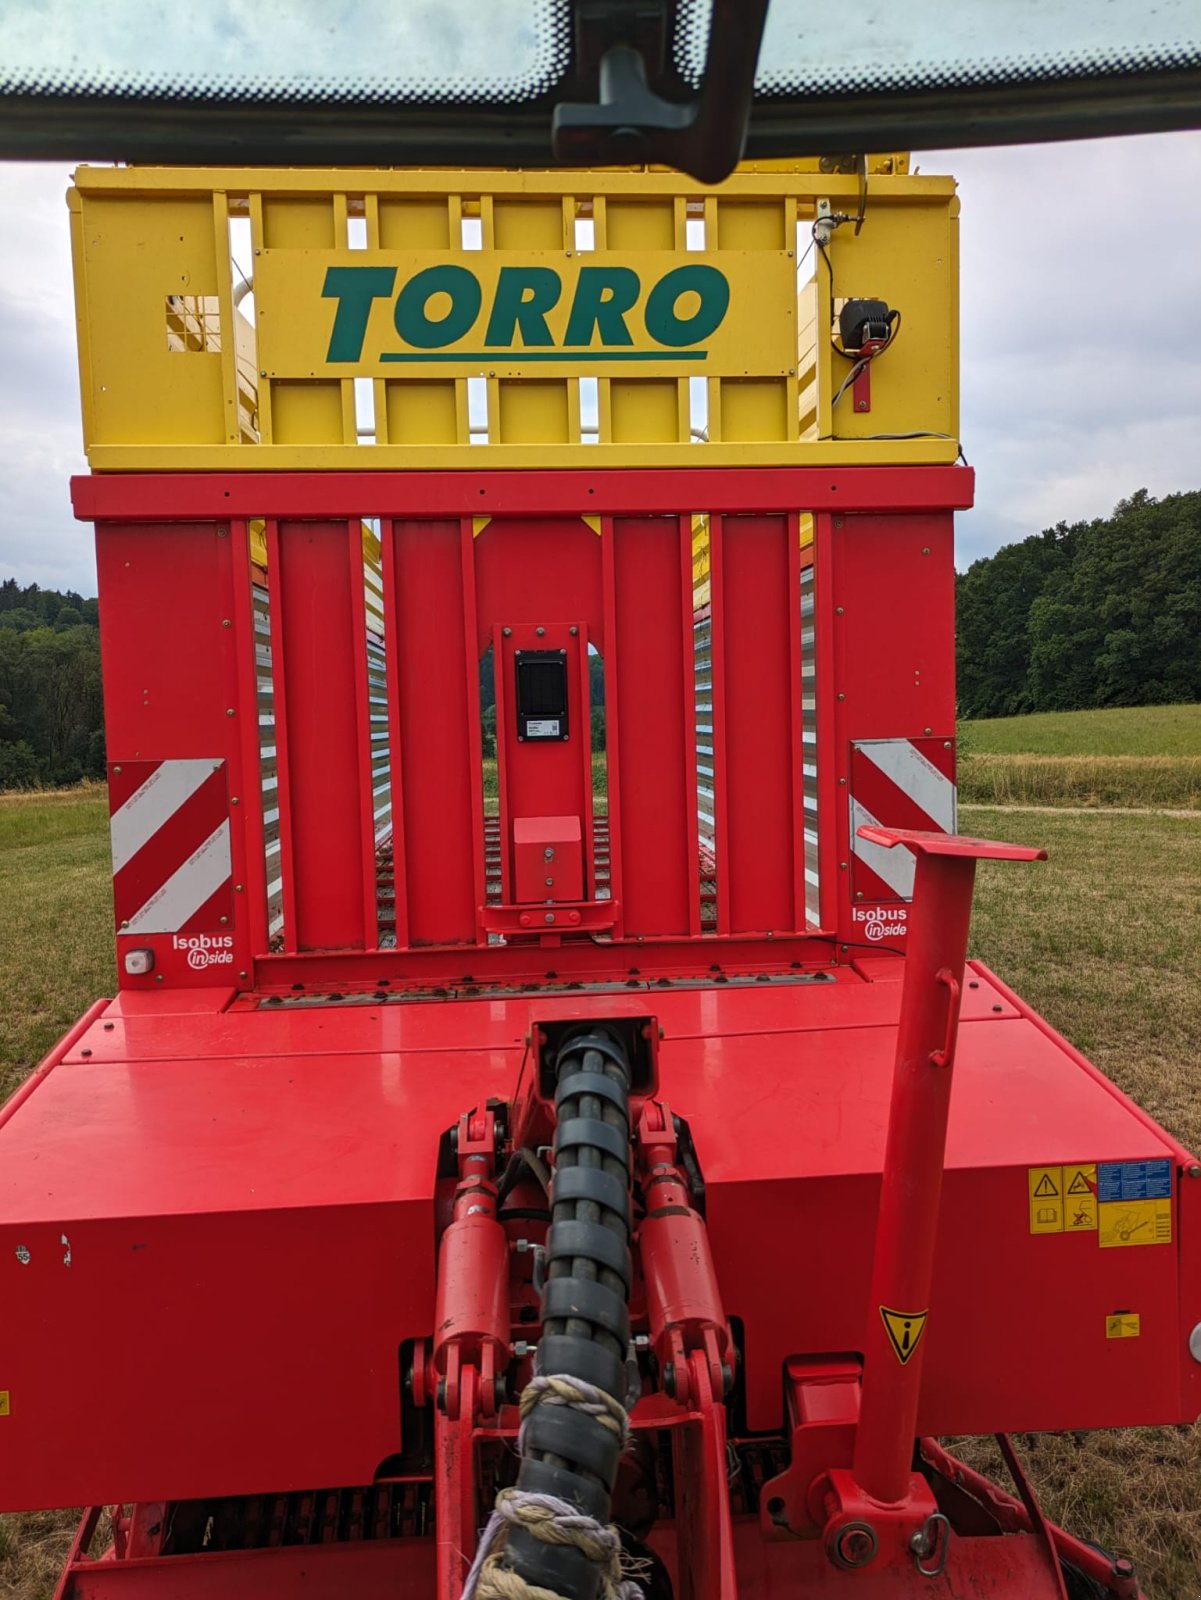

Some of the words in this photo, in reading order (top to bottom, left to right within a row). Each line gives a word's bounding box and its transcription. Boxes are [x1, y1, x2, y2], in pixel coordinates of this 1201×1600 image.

[321, 264, 730, 363] TORRO
[852, 906, 907, 921] Isobus
[865, 920, 907, 941] inside
[173, 934, 233, 950] Isobus
[187, 947, 234, 970] inside
